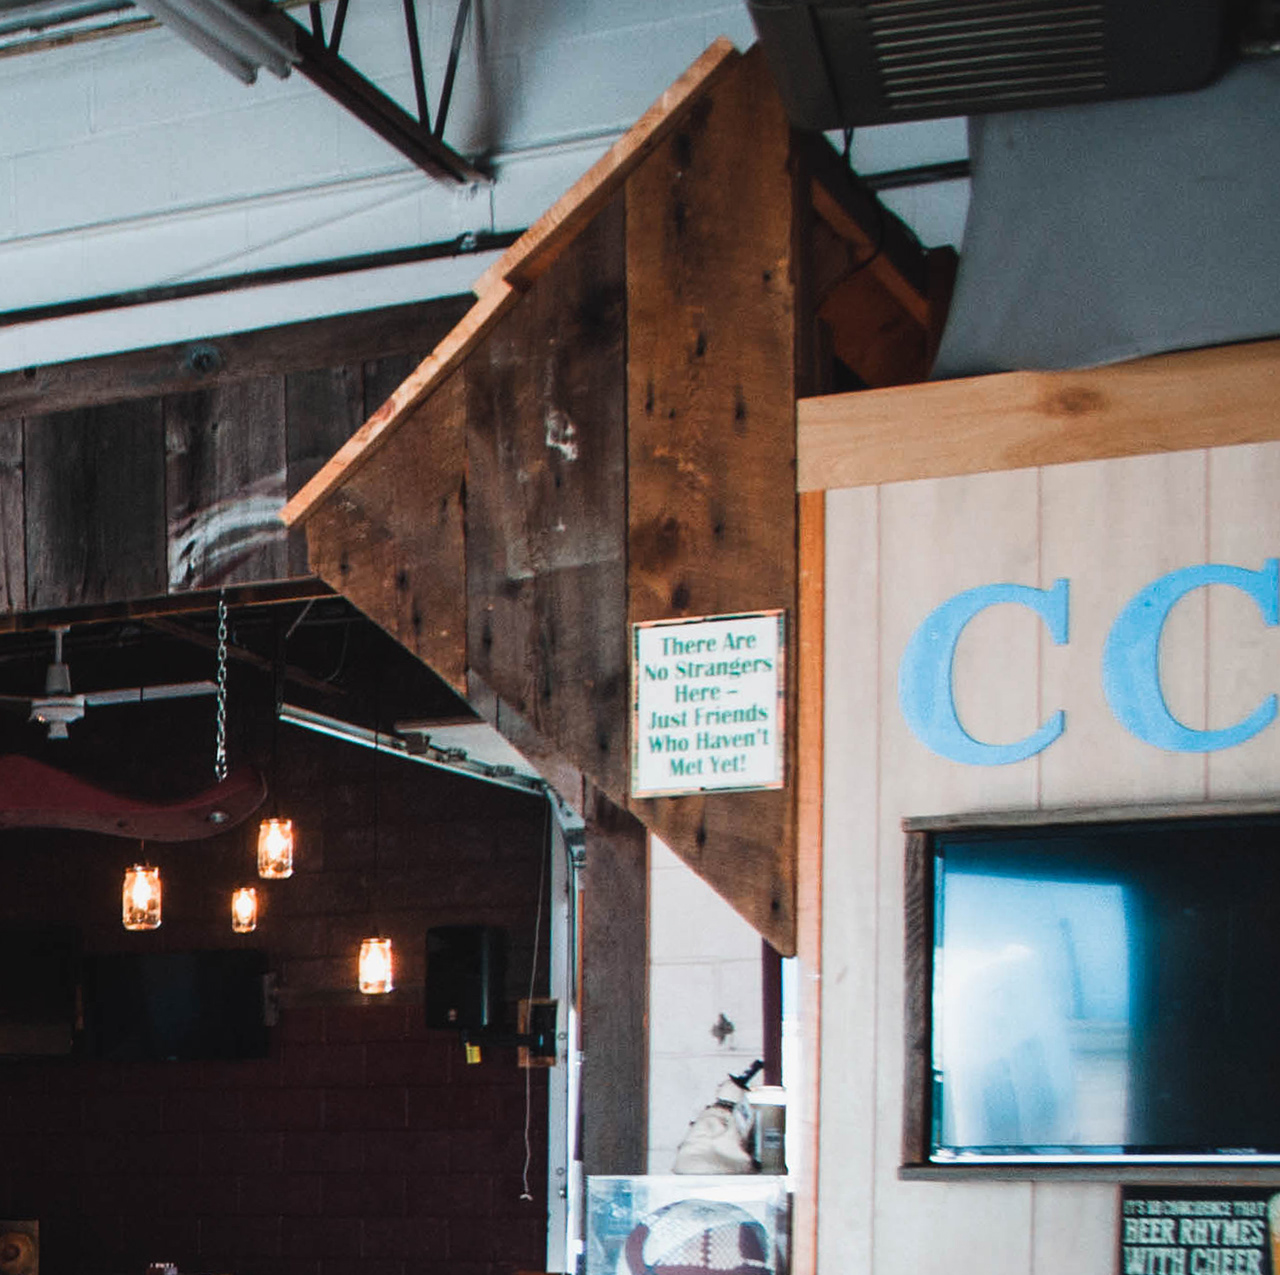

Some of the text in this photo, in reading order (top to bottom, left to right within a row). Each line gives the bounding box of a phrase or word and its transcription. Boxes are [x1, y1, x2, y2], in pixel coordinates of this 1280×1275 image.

[660, 632, 757, 656] There Are
[645, 657, 773, 681] No Strangers
[675, 684, 721, 703] Here
[648, 704, 769, 730] Just Friends
[648, 728, 769, 754] Who Haven't
[669, 754, 747, 777] Met Yet!
[1123, 1217, 1265, 1246] BEER RHYMES
